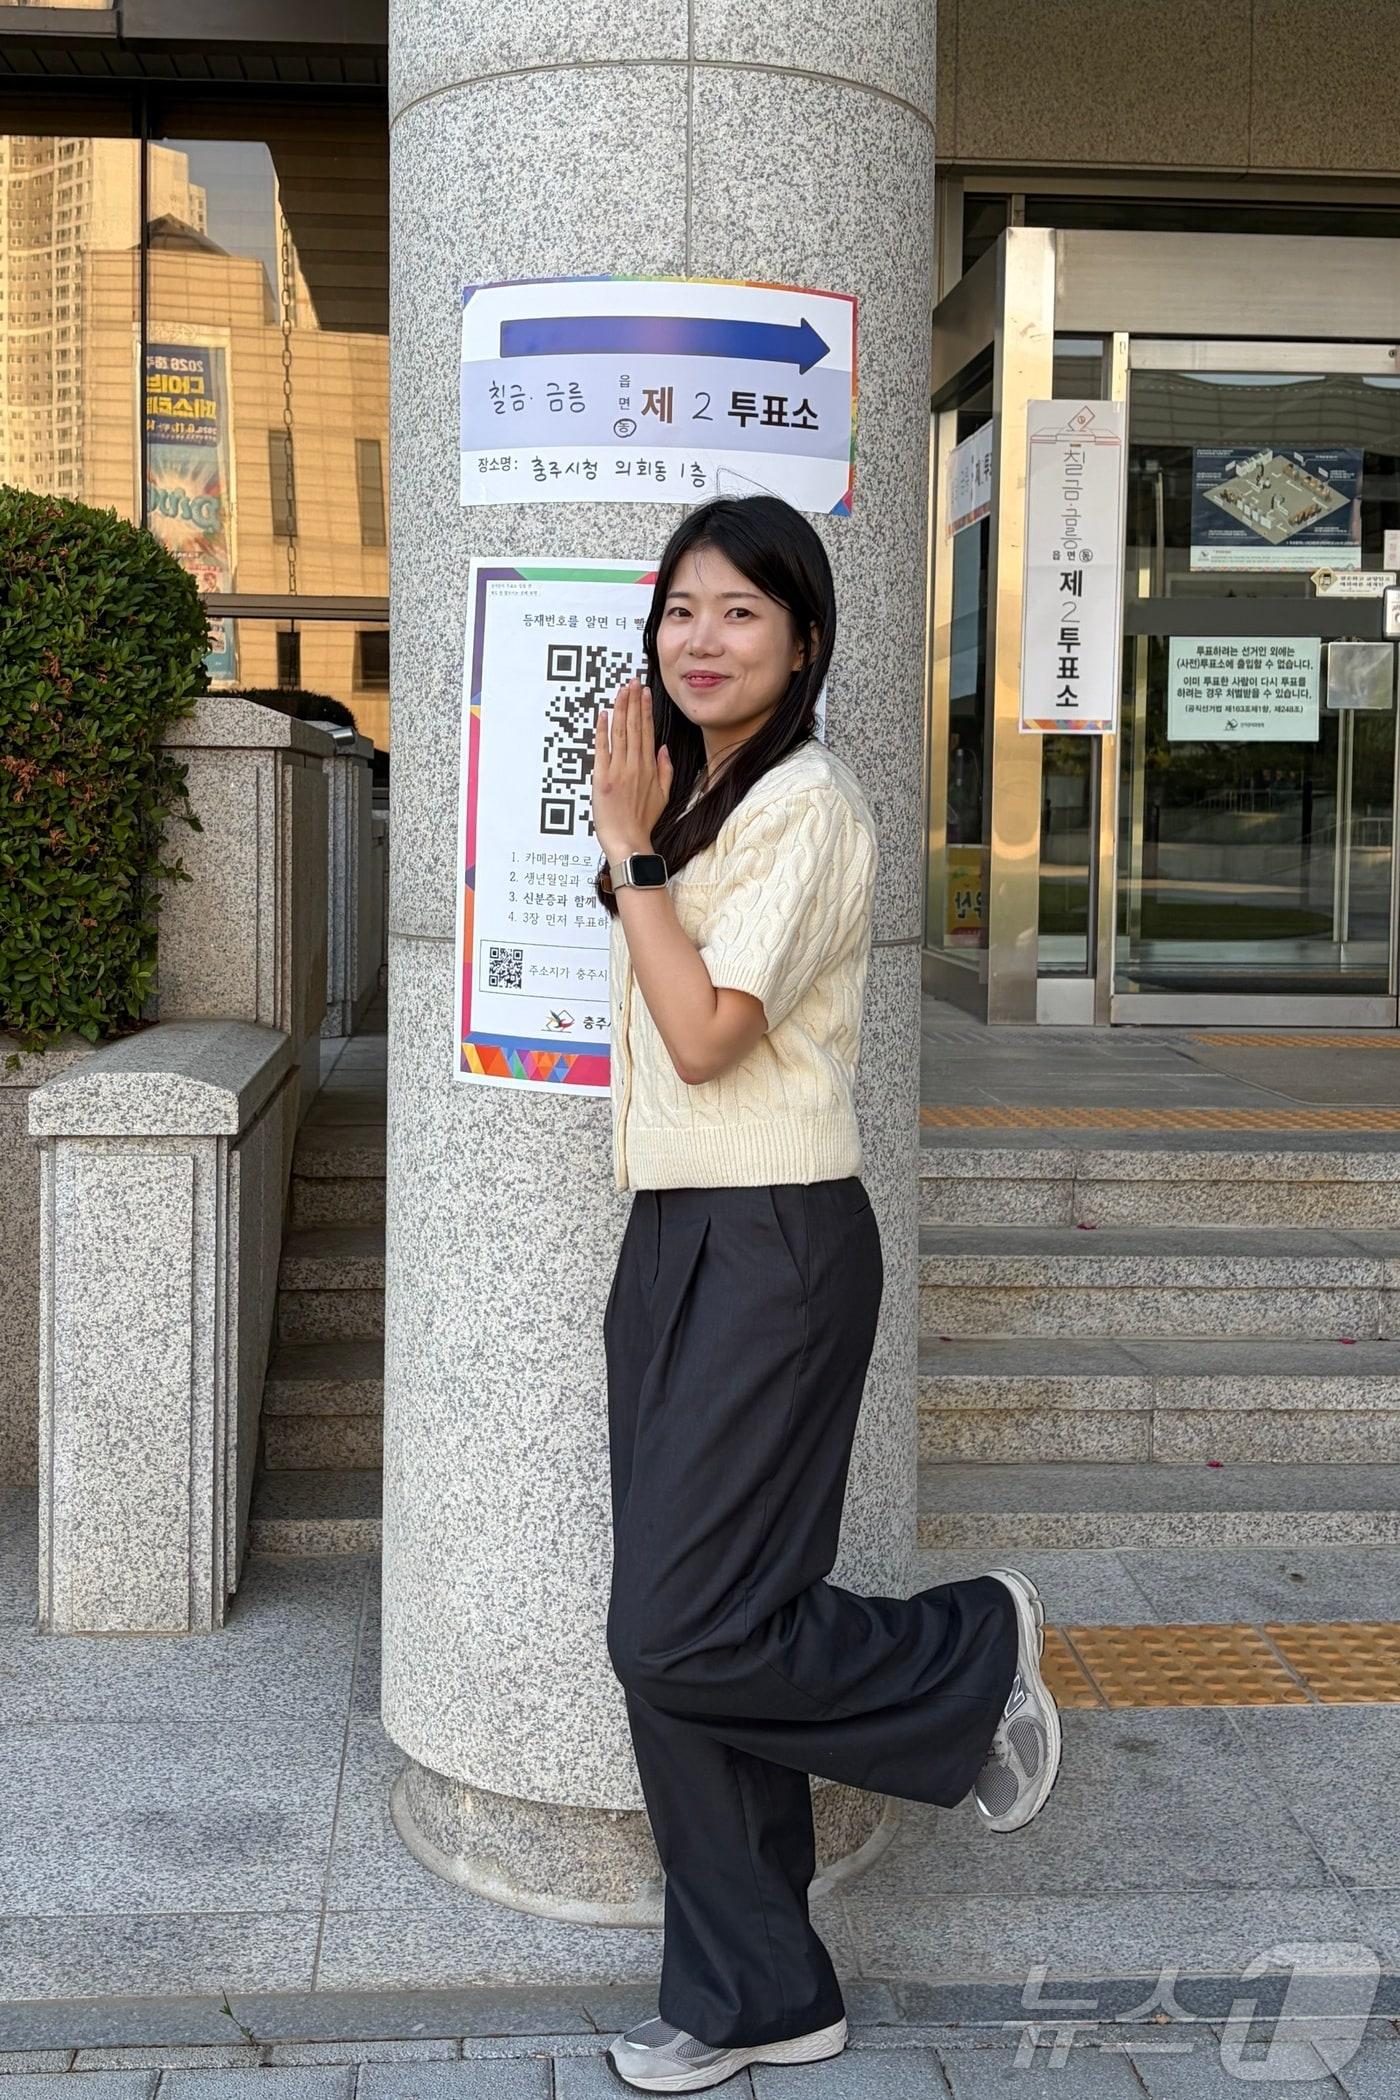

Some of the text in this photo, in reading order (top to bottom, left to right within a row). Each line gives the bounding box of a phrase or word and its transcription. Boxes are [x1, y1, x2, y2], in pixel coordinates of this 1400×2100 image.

[546, 382, 586, 413] 금릉
[641, 386, 674, 424] 제
[692, 391, 714, 421] 2
[727, 390, 820, 431] 투표소
[478, 455, 518, 473] 장소명:
[531, 456, 598, 482] 충주시청
[615, 458, 667, 482] 의회동
[522, 614, 579, 628] 등재번호를
[585, 616, 609, 629] 알면
[616, 617, 626, 630] 더
[1197, 646, 1295, 656] 투표하려는 선거인 외에는
[1177, 658, 1314, 670] (사전)투표소에 출입할 수 없습니다.
[1183, 677, 1307, 687] 이미 투표한 사람이 다시 투표를
[1177, 689, 1312, 699] 하려는 경우 처벌받을 수 있습니다.
[511, 852, 593, 867] 1. 카메라앱으로
[509, 871, 518, 882] 2.
[524, 872, 579, 887] 생년월일과
[509, 891, 597, 908] 3. 신분증과 함께
[508, 911, 517, 922] 4.
[522, 912, 539, 925] 3장
[529, 965, 607, 981] 주소지가 충주시
